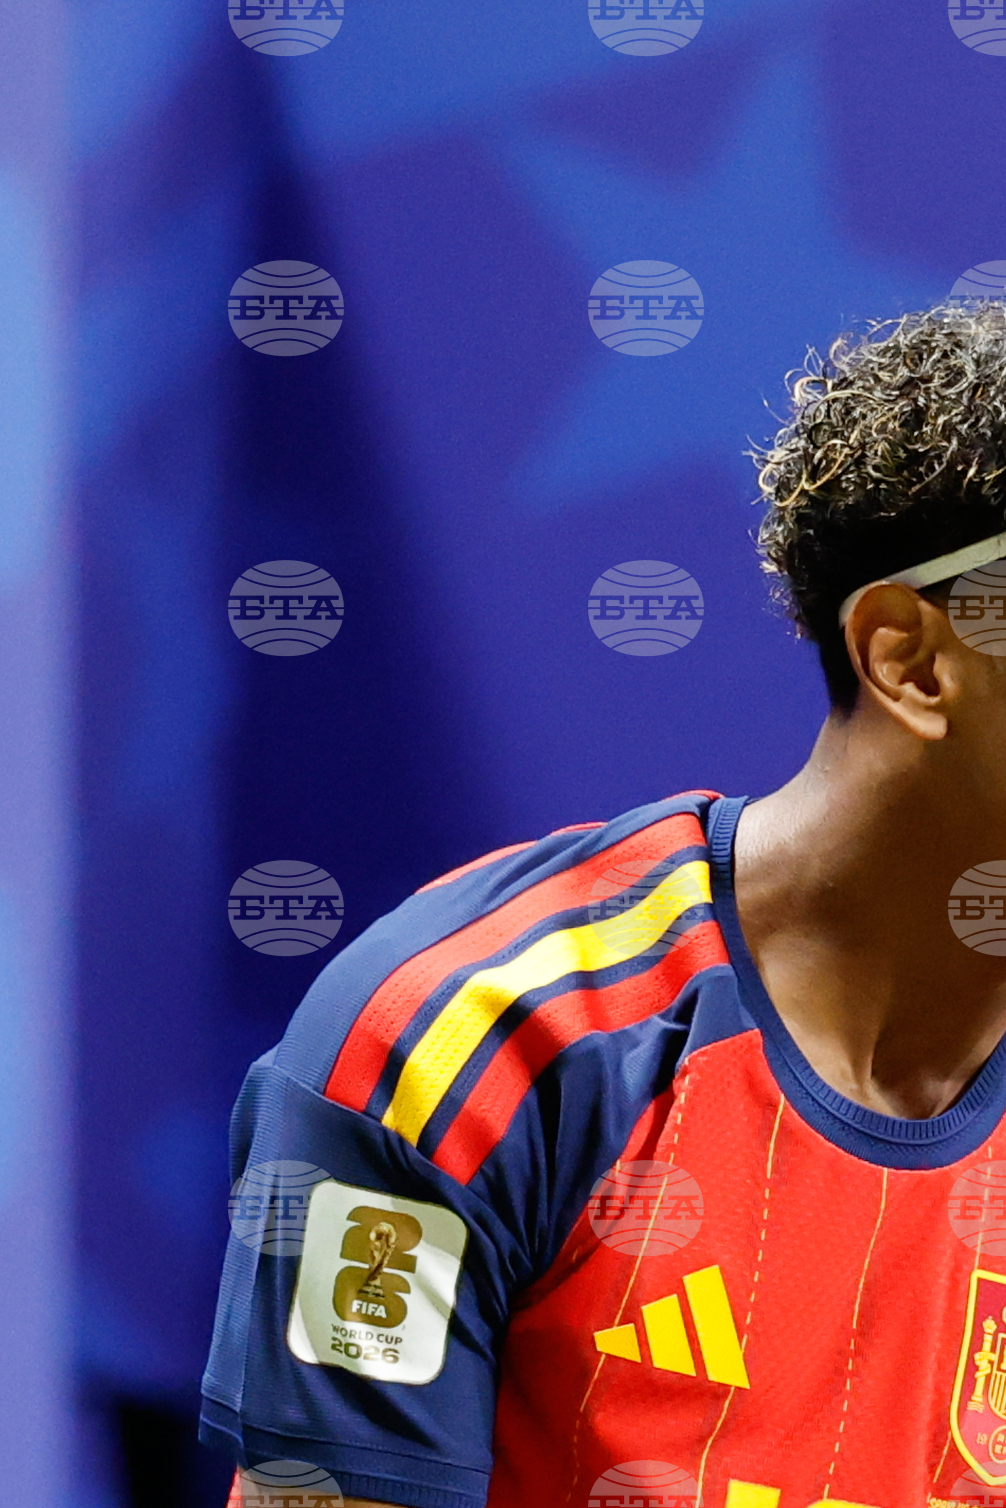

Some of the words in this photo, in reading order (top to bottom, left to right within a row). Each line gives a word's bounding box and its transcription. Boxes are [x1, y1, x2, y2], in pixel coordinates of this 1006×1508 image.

[351, 1299, 387, 1319] FIFA
[331, 1323, 374, 1341] WORLD
[376, 1333, 403, 1345] CUP
[331, 1336, 400, 1364] 2026
